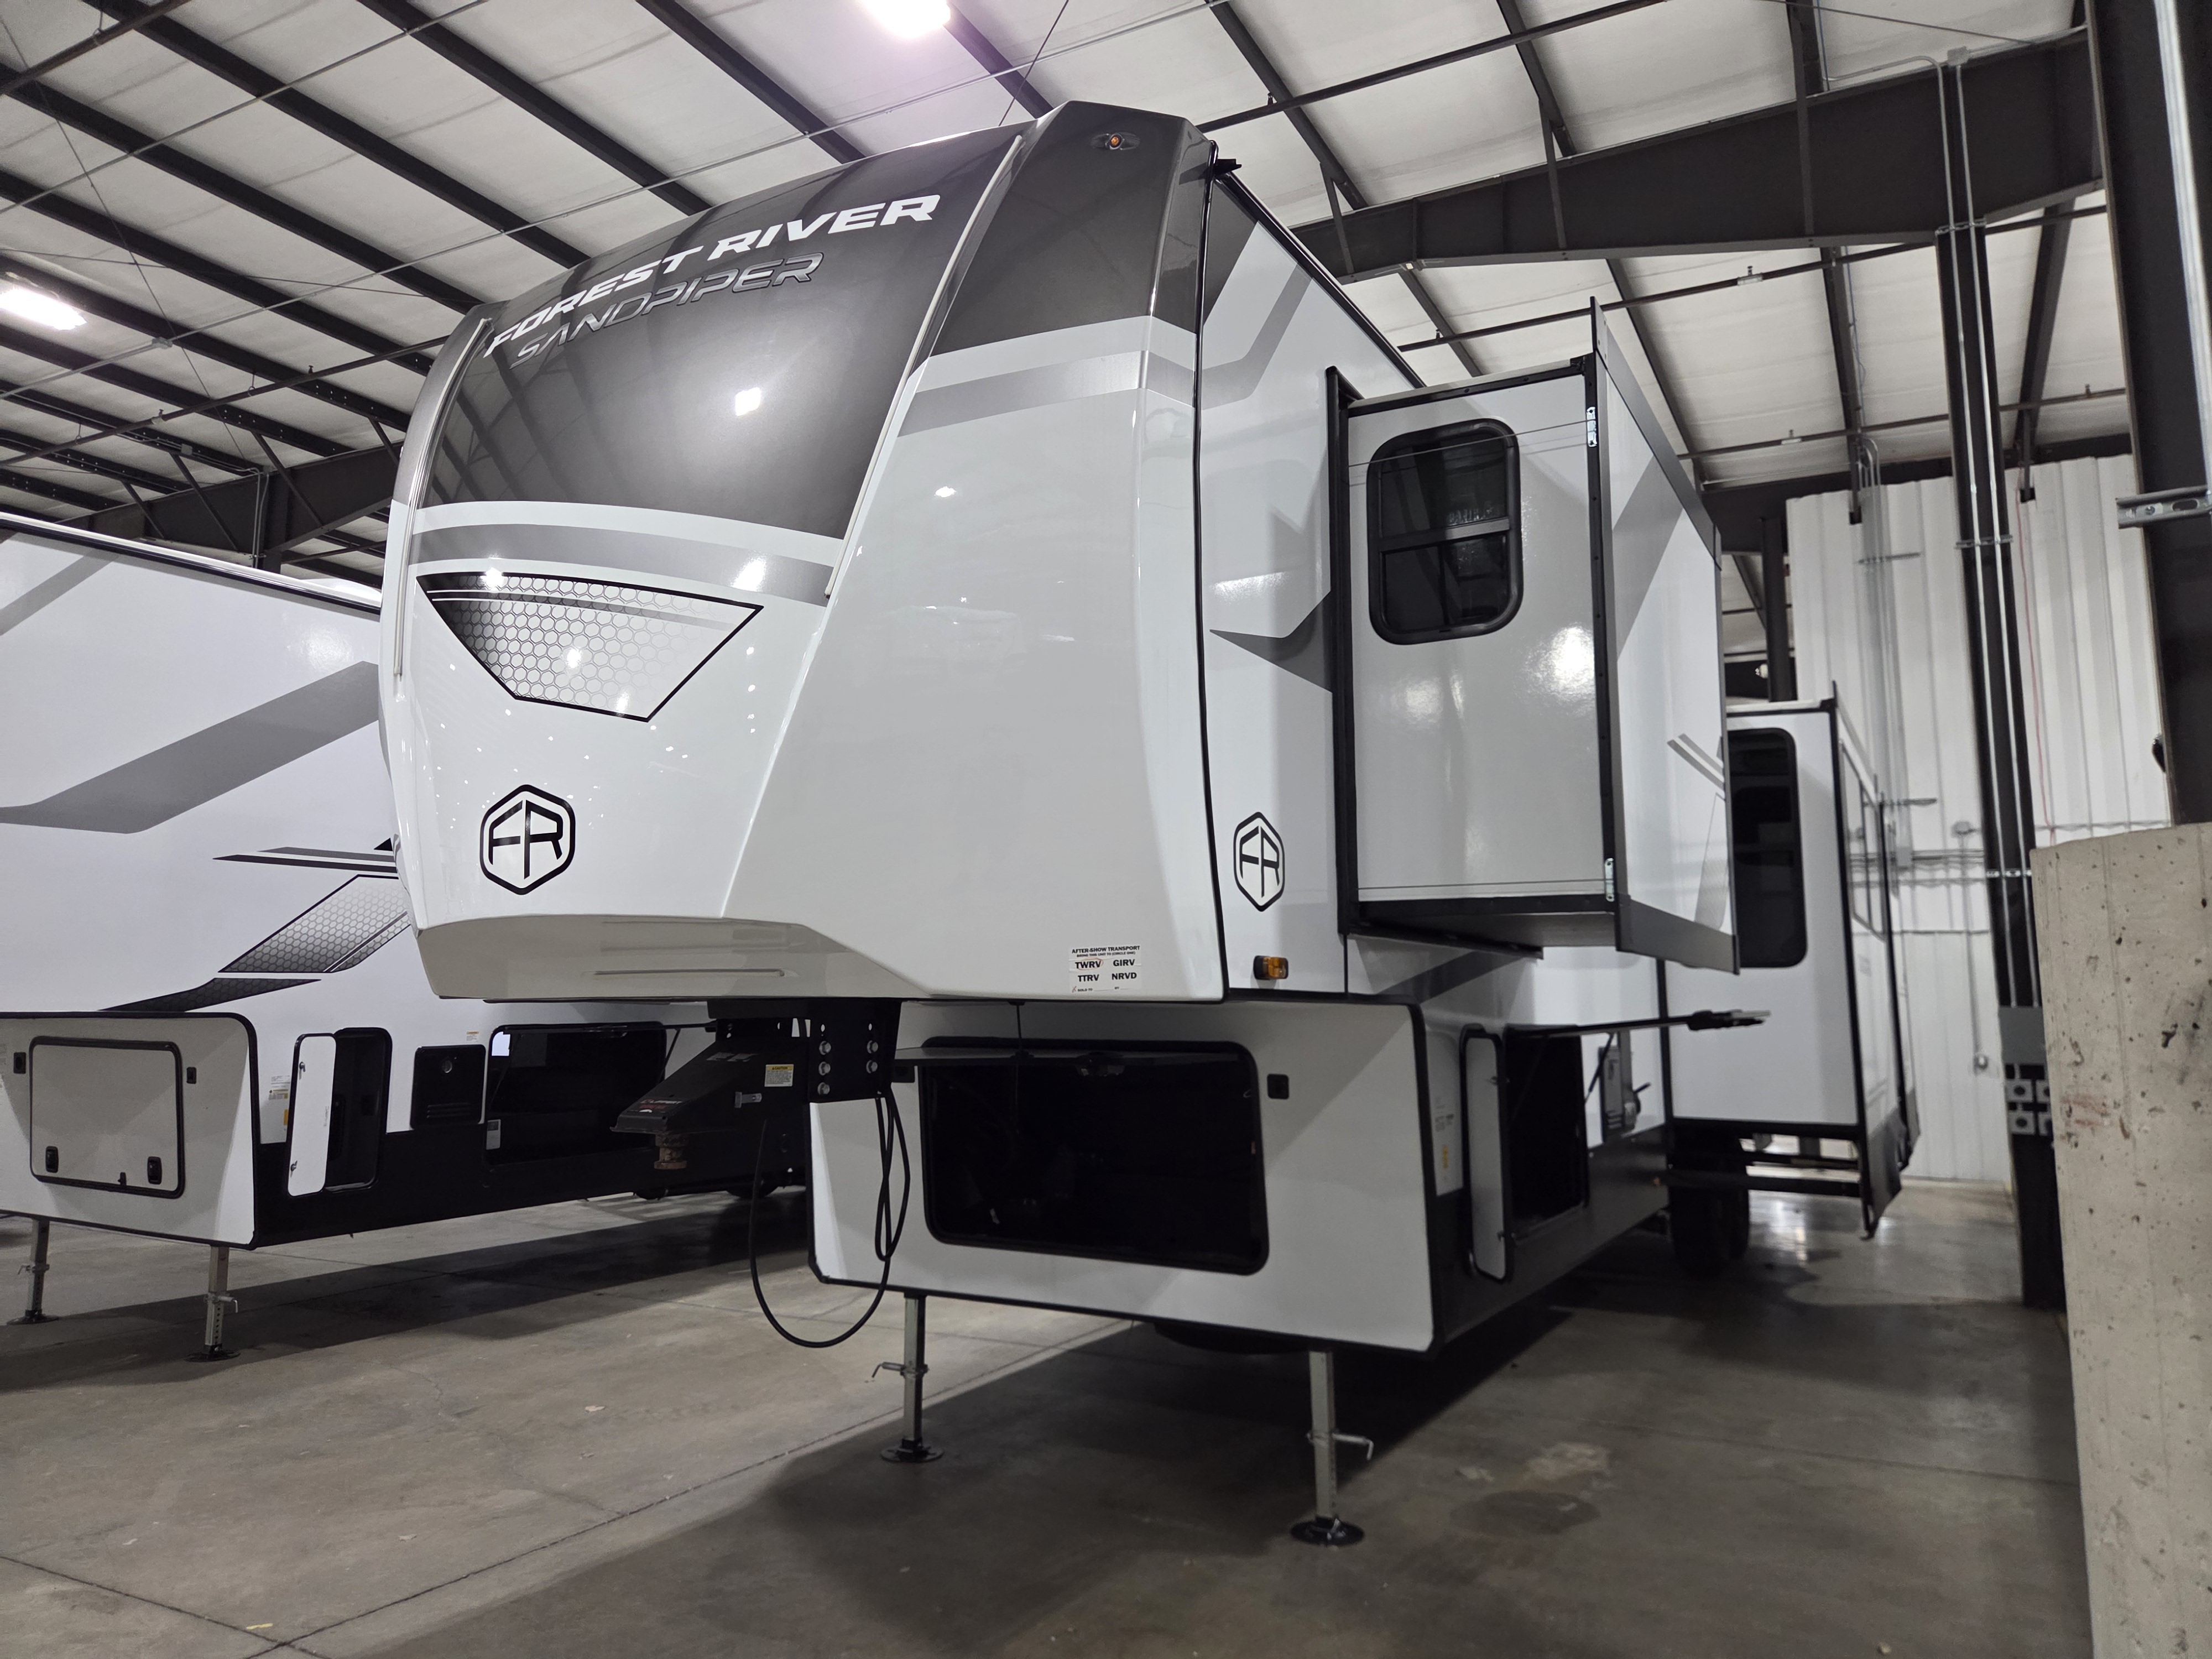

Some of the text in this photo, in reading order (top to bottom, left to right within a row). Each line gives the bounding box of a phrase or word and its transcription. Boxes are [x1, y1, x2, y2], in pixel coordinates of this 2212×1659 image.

[483, 194, 941, 358] FOREST RIVER
[508, 251, 825, 371] SANDPIPER
[1075, 961, 1101, 969] TWRV
[1078, 974, 1099, 982] TTRV
